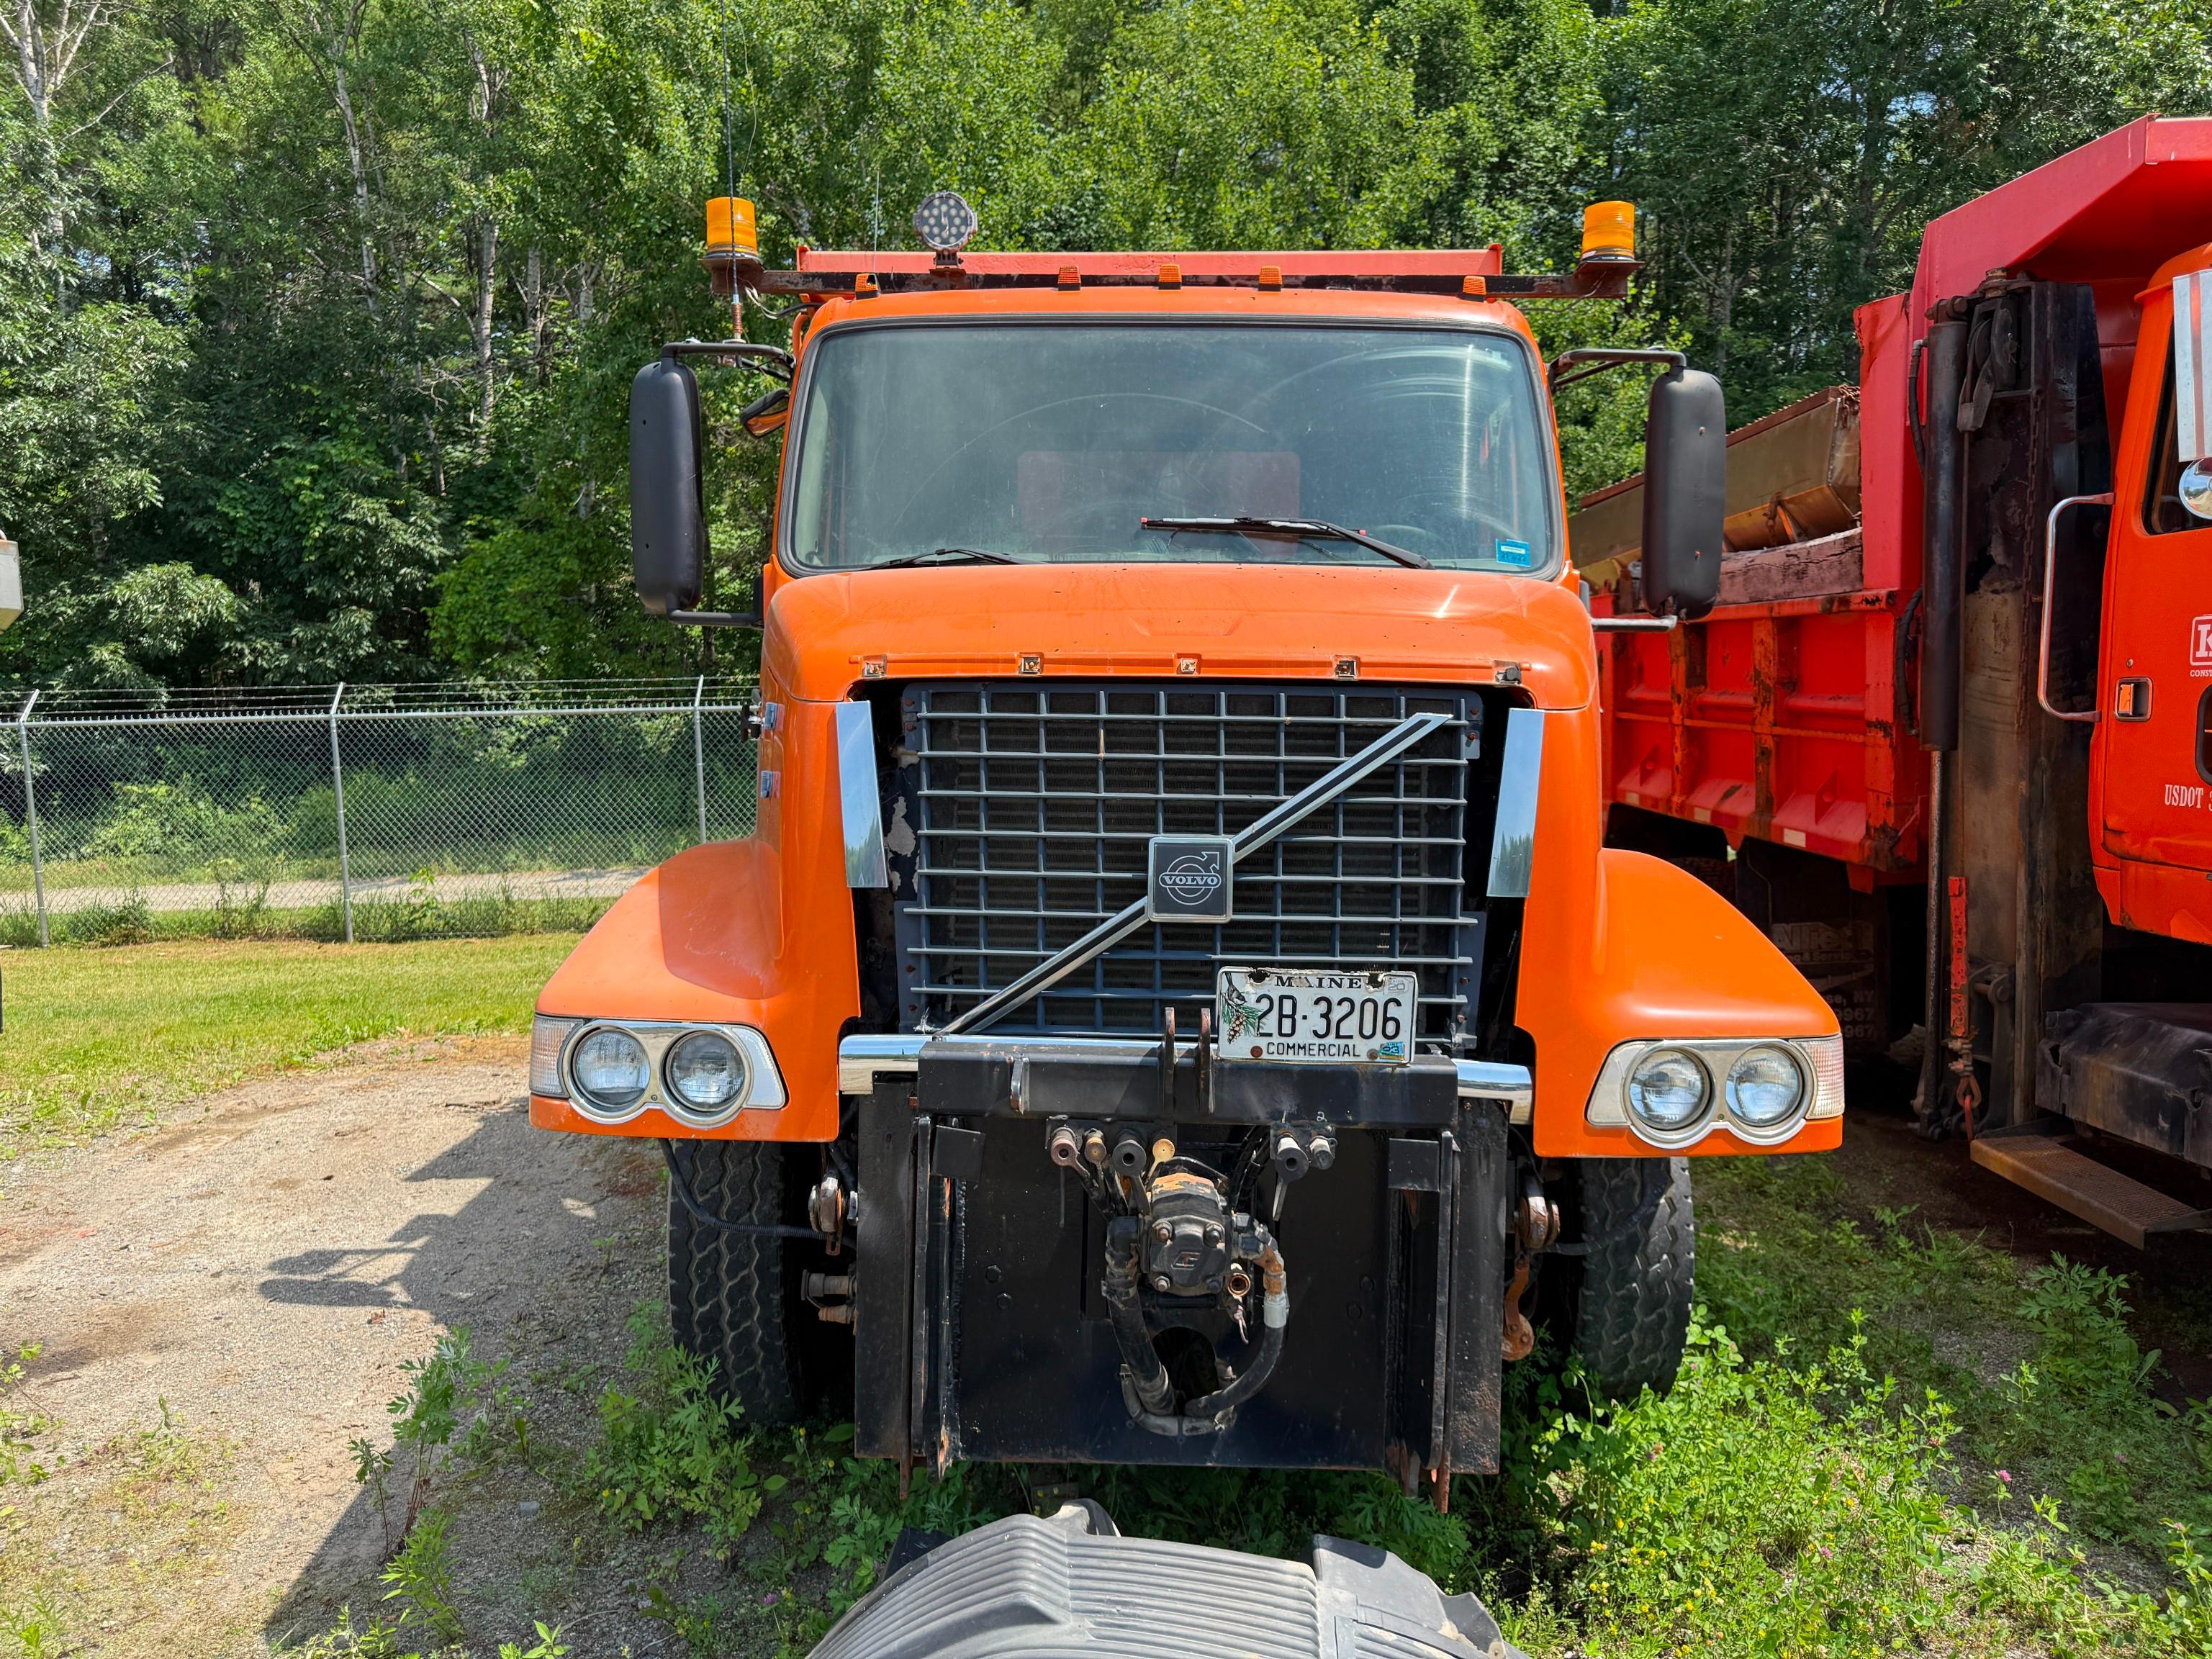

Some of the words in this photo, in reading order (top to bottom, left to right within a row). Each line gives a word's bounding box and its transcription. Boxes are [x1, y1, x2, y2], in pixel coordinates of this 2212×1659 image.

[2164, 784, 2204, 808] USDOT
[1163, 875, 1218, 885] VOLVO
[1266, 1041, 1360, 1057] COMMERCIAL
[1317, 1111, 1327, 1122] 2
